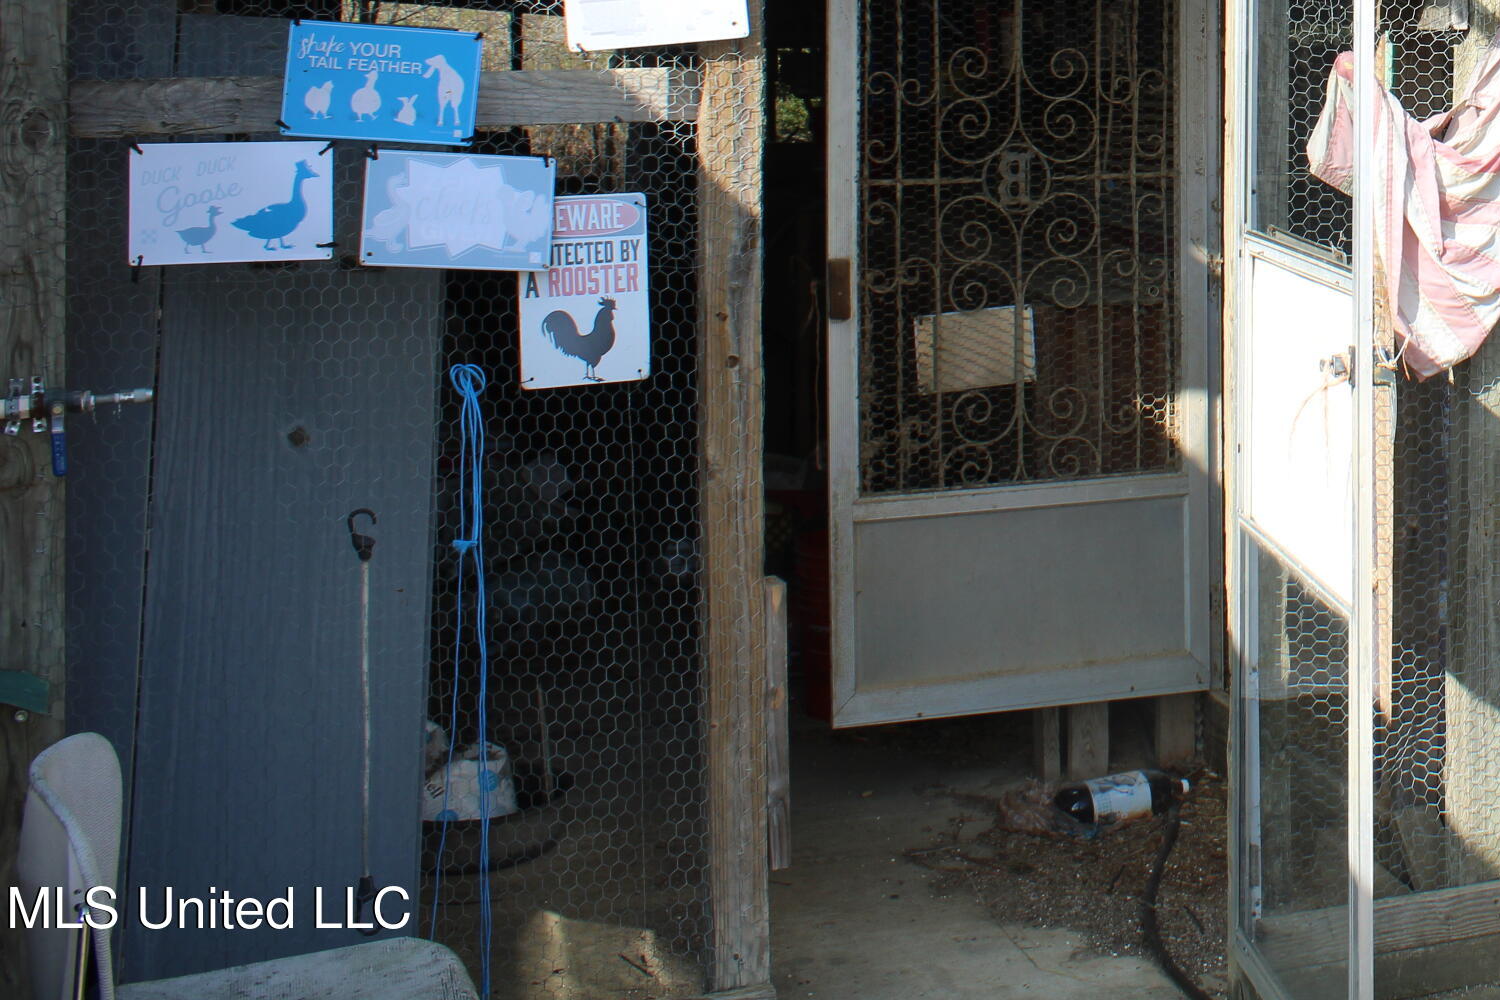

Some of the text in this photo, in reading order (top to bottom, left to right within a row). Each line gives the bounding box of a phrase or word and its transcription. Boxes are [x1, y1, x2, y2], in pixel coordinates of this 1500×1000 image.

[349, 41, 401, 58] YOUR
[308, 55, 422, 75] TAIL FEATHER
[141, 156, 238, 186] DUCK DUCK
[156, 181, 243, 227] Goose
[555, 203, 625, 232] EWARE
[551, 239, 641, 267] TECTED BY
[525, 263, 640, 299] A ROOSTER
